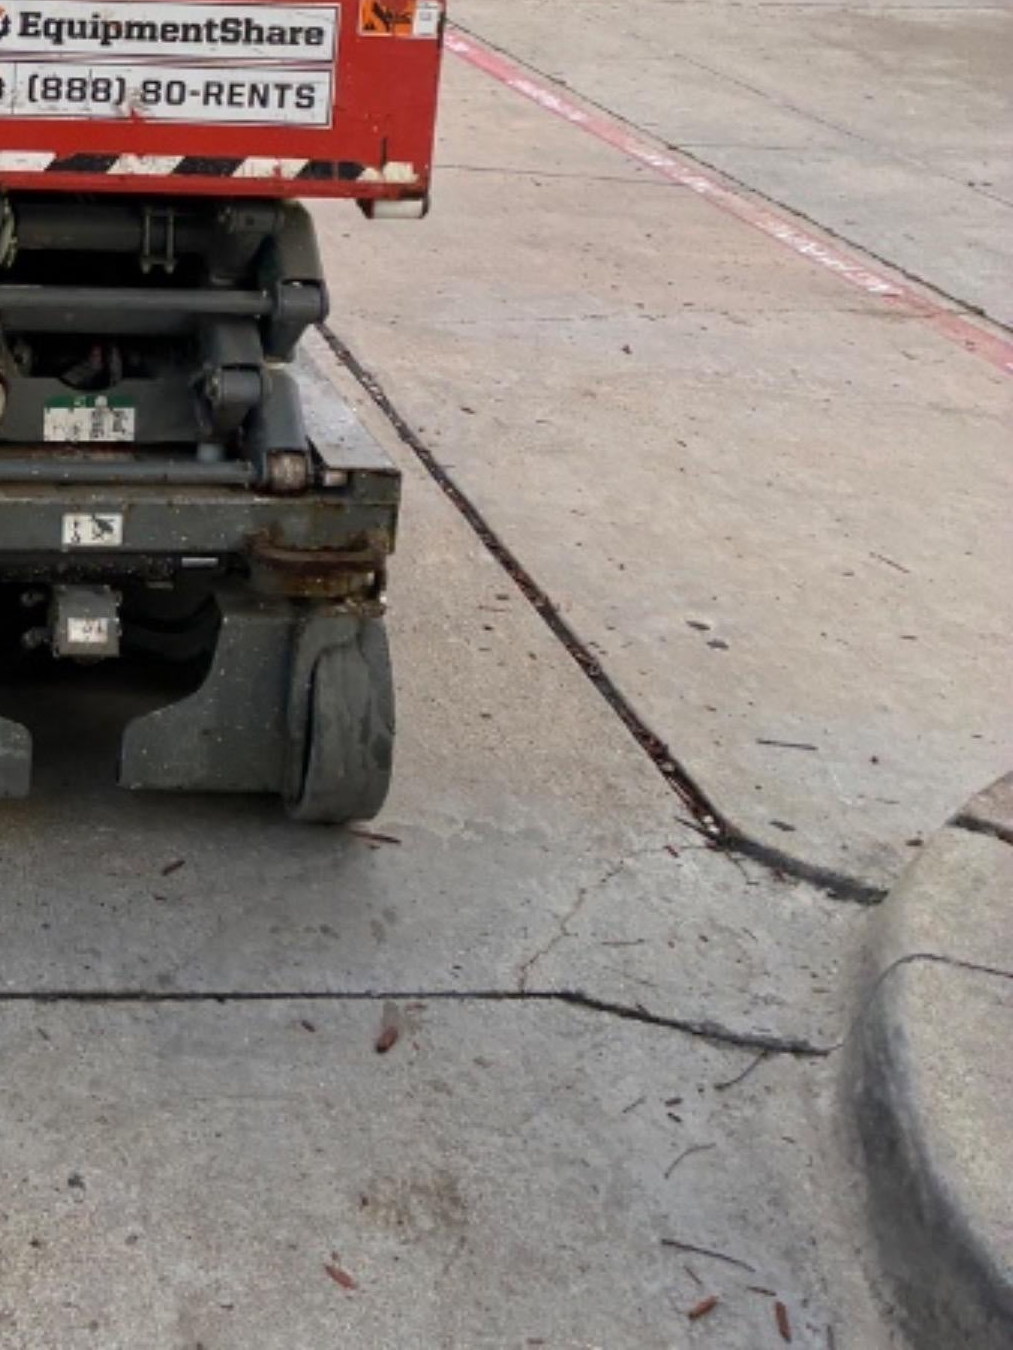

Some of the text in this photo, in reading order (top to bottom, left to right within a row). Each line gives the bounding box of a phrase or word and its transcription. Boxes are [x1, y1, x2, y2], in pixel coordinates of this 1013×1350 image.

[17, 10, 324, 47] EquipmentShare
[28, 73, 316, 110] (888) 80-RENTS
